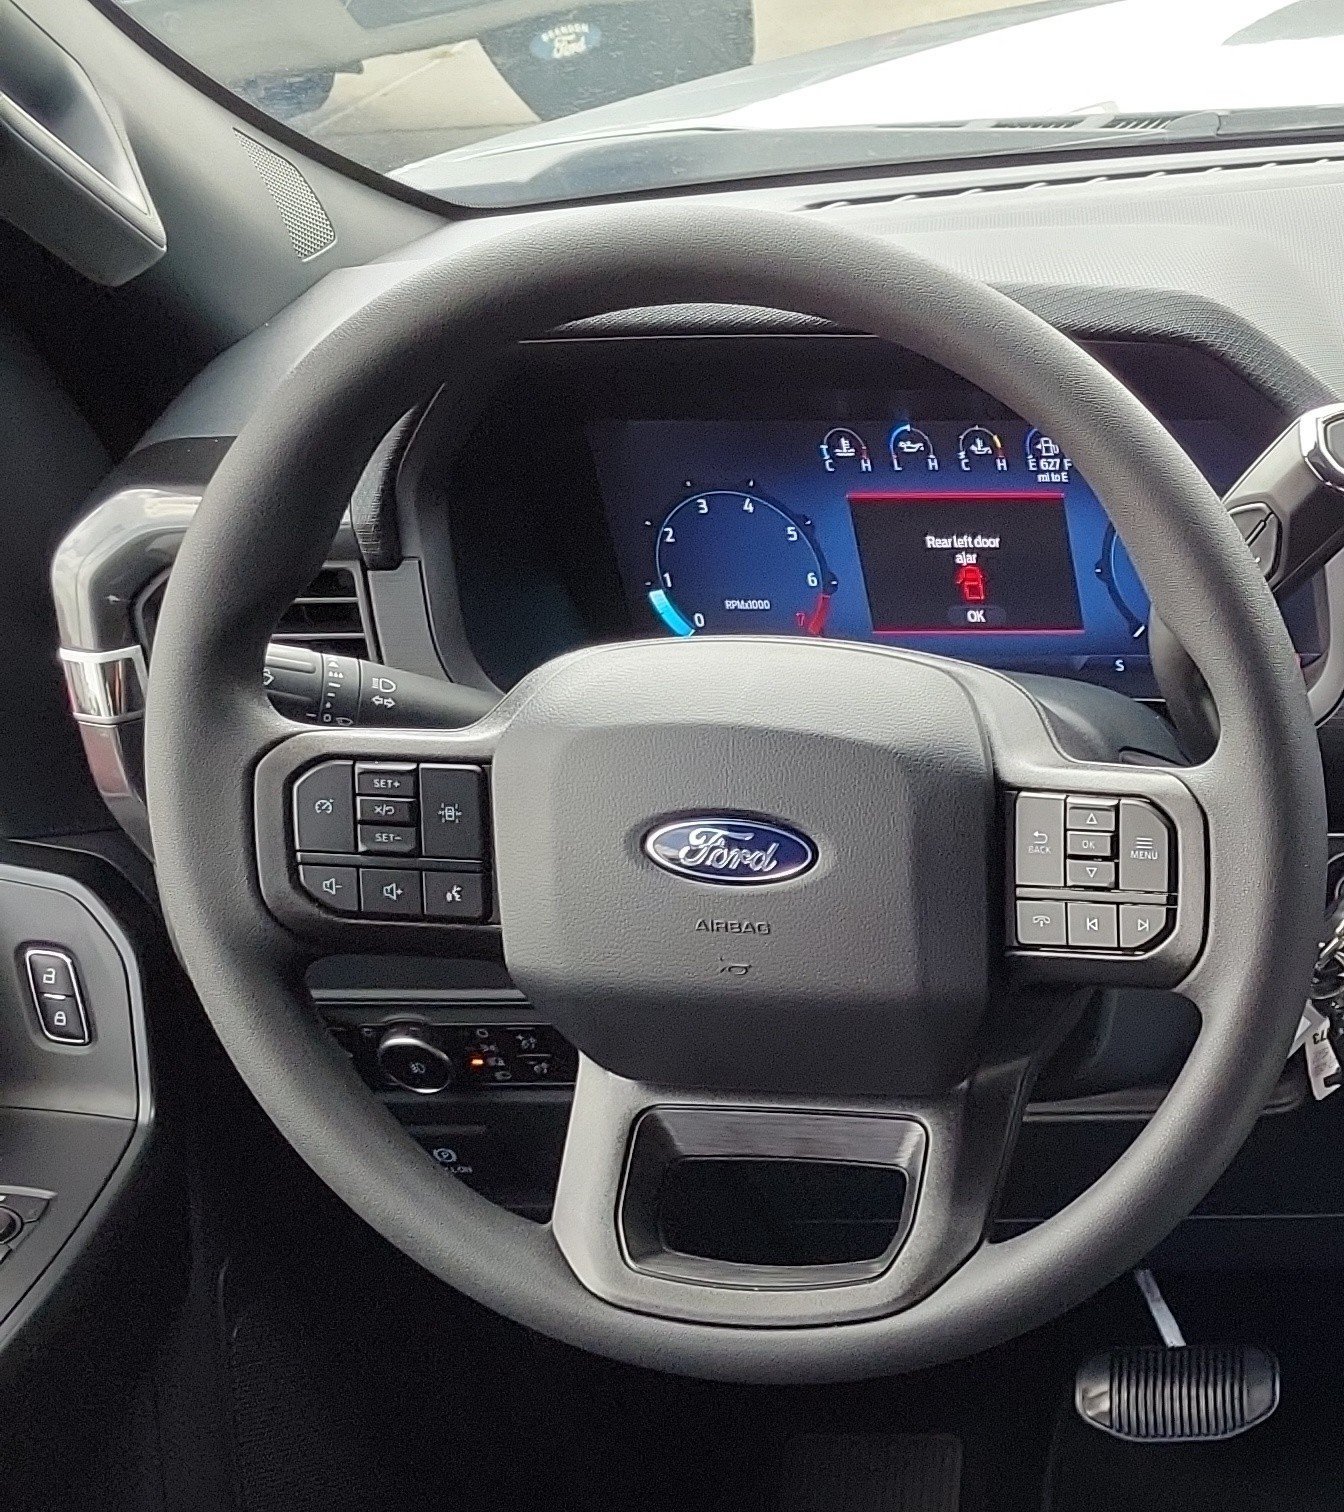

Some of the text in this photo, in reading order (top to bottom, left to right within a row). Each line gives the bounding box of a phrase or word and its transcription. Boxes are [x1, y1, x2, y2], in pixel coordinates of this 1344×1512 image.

[825, 459, 835, 472] C
[861, 459, 872, 472] H
[893, 459, 903, 471] L
[928, 458, 939, 471] H
[961, 458, 971, 471] C
[996, 458, 1008, 471] H
[1028, 459, 1038, 471] E
[1039, 458, 1061, 471] 627
[1061, 472, 1069, 482] E
[697, 498, 709, 514] 3
[743, 498, 754, 514] 4
[664, 528, 676, 543] 2
[787, 526, 798, 541] 5
[926, 534, 1001, 549] Rear left door
[955, 552, 978, 567] ajar
[663, 573, 672, 588] 1
[807, 572, 818, 587] 6
[693, 613, 705, 628] 0
[966, 610, 986, 623] OK
[373, 778, 401, 790] SET+
[678, 826, 776, 873] Ford
[1028, 844, 1051, 854] BACK
[1081, 839, 1096, 849] OK
[1130, 849, 1158, 860] MENU
[695, 918, 772, 935] AIRBAG
